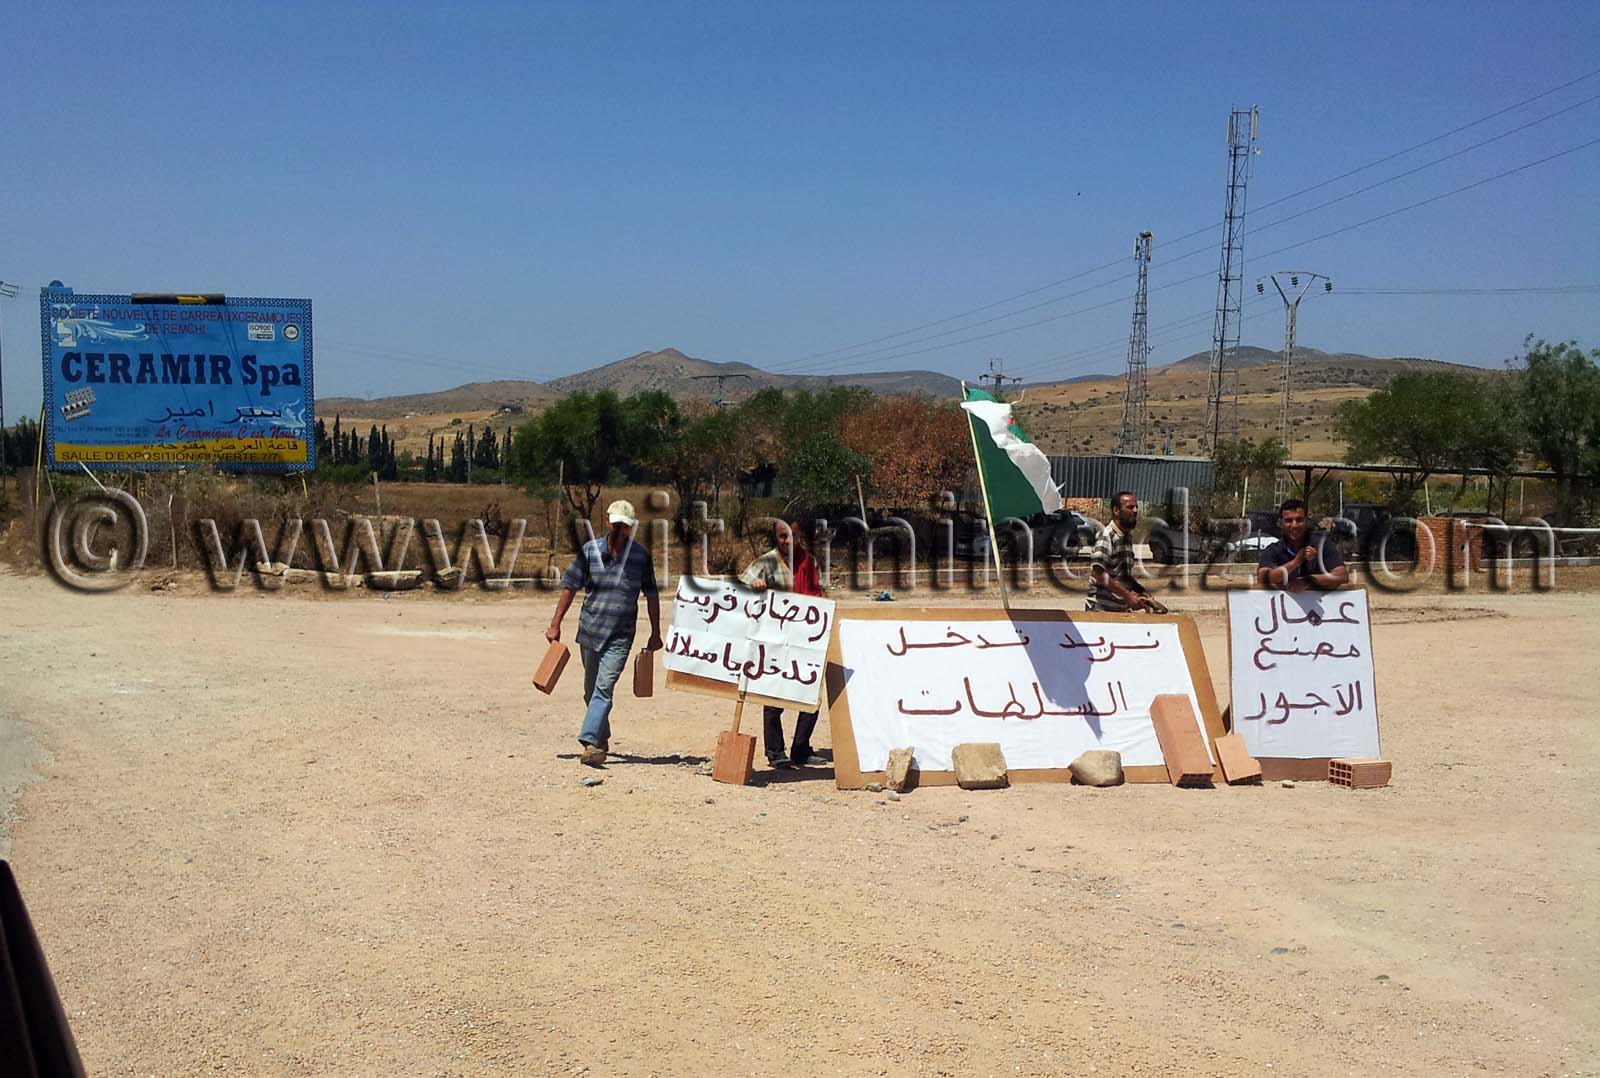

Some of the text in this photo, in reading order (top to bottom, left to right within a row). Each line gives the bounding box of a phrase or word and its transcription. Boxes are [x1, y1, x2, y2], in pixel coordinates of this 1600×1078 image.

[103, 308, 160, 321] NOUVELLE
[163, 309, 177, 321] DE
[145, 323, 159, 335] DE
[61, 352, 302, 396] CERAMIR Spa
[62, 451, 100, 461] SALLE
[105, 451, 194, 461] D'EXPOSITION
[198, 452, 257, 461] OUVERTE
[675, 586, 739, 624] قريب
[1254, 592, 1360, 635] عمال
[886, 625, 1160, 662] نريد تدخل
[1253, 636, 1361, 671] مصنع
[897, 676, 1129, 721] السلطات
